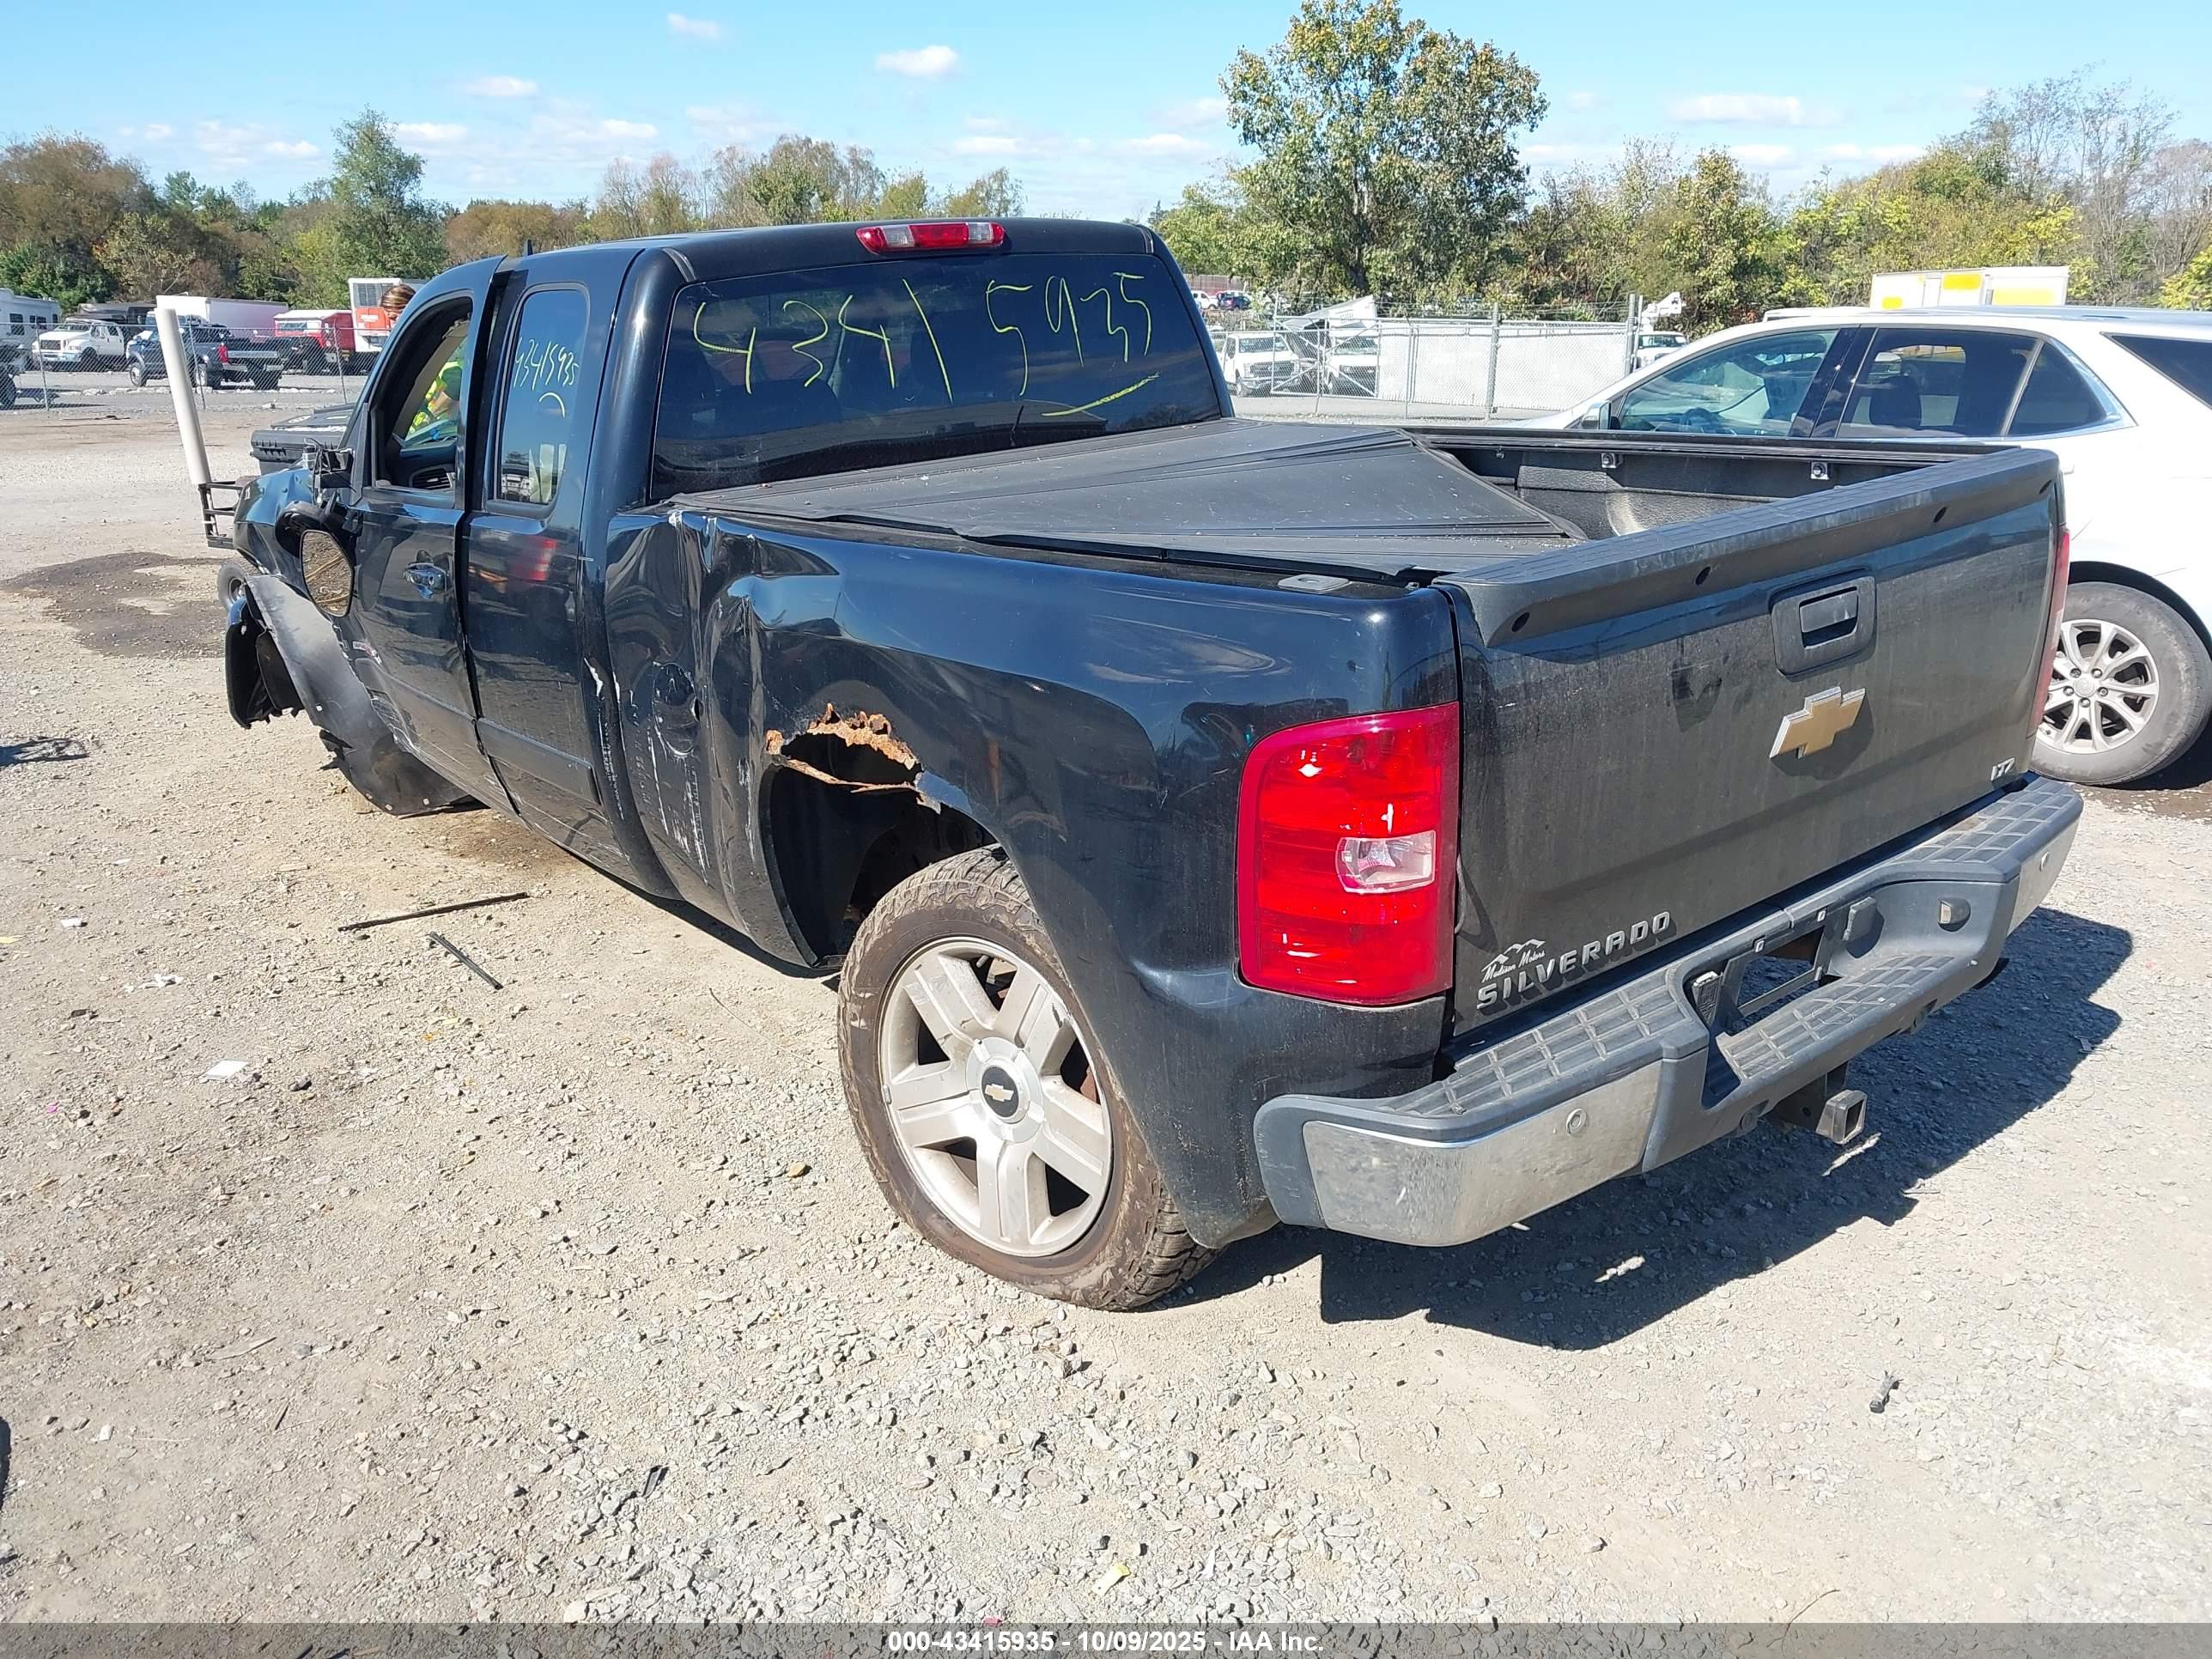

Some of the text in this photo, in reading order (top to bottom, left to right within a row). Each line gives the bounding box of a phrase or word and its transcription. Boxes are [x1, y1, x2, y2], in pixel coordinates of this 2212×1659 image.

[1990, 757, 2015, 781] LTZ
[1477, 911, 1670, 1009] SILVERADO
[1481, 950, 1546, 983] Madison Motors
